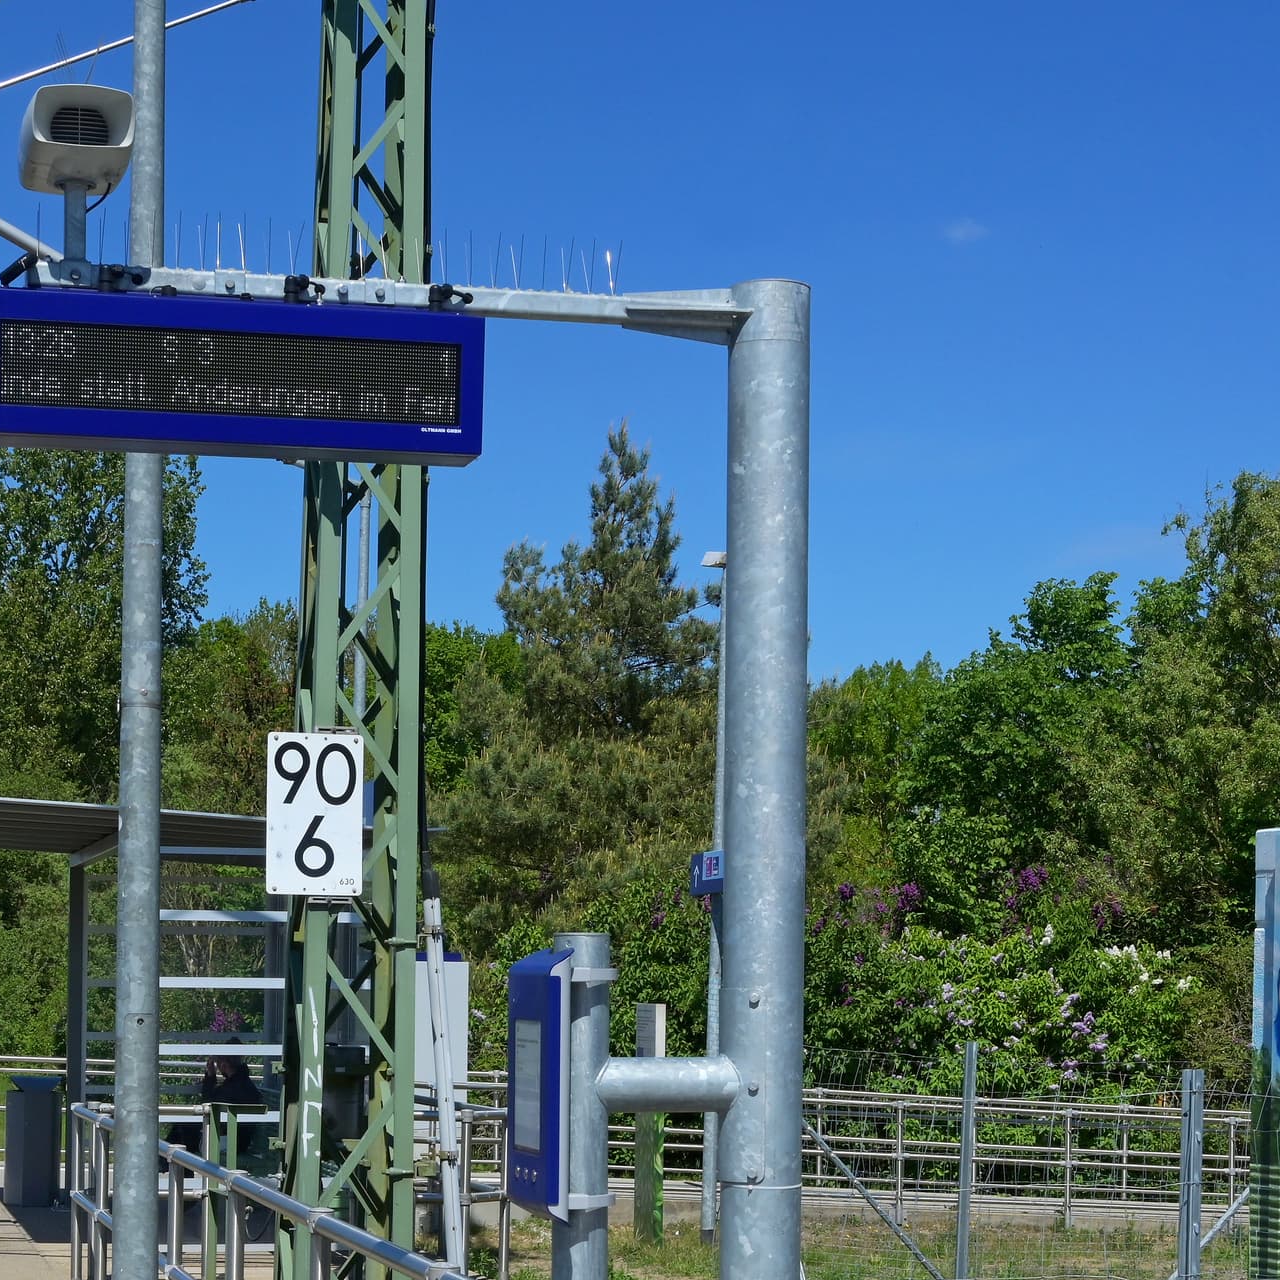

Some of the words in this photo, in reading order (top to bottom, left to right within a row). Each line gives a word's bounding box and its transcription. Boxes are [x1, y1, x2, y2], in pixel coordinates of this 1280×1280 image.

[163, 335, 179, 363] S
[198, 337, 214, 365] 3
[172, 376, 342, 416] Änderungen
[360, 384, 387, 413] im
[274, 741, 357, 806] 90
[294, 815, 335, 878] 6
[339, 878, 355, 887] 630
